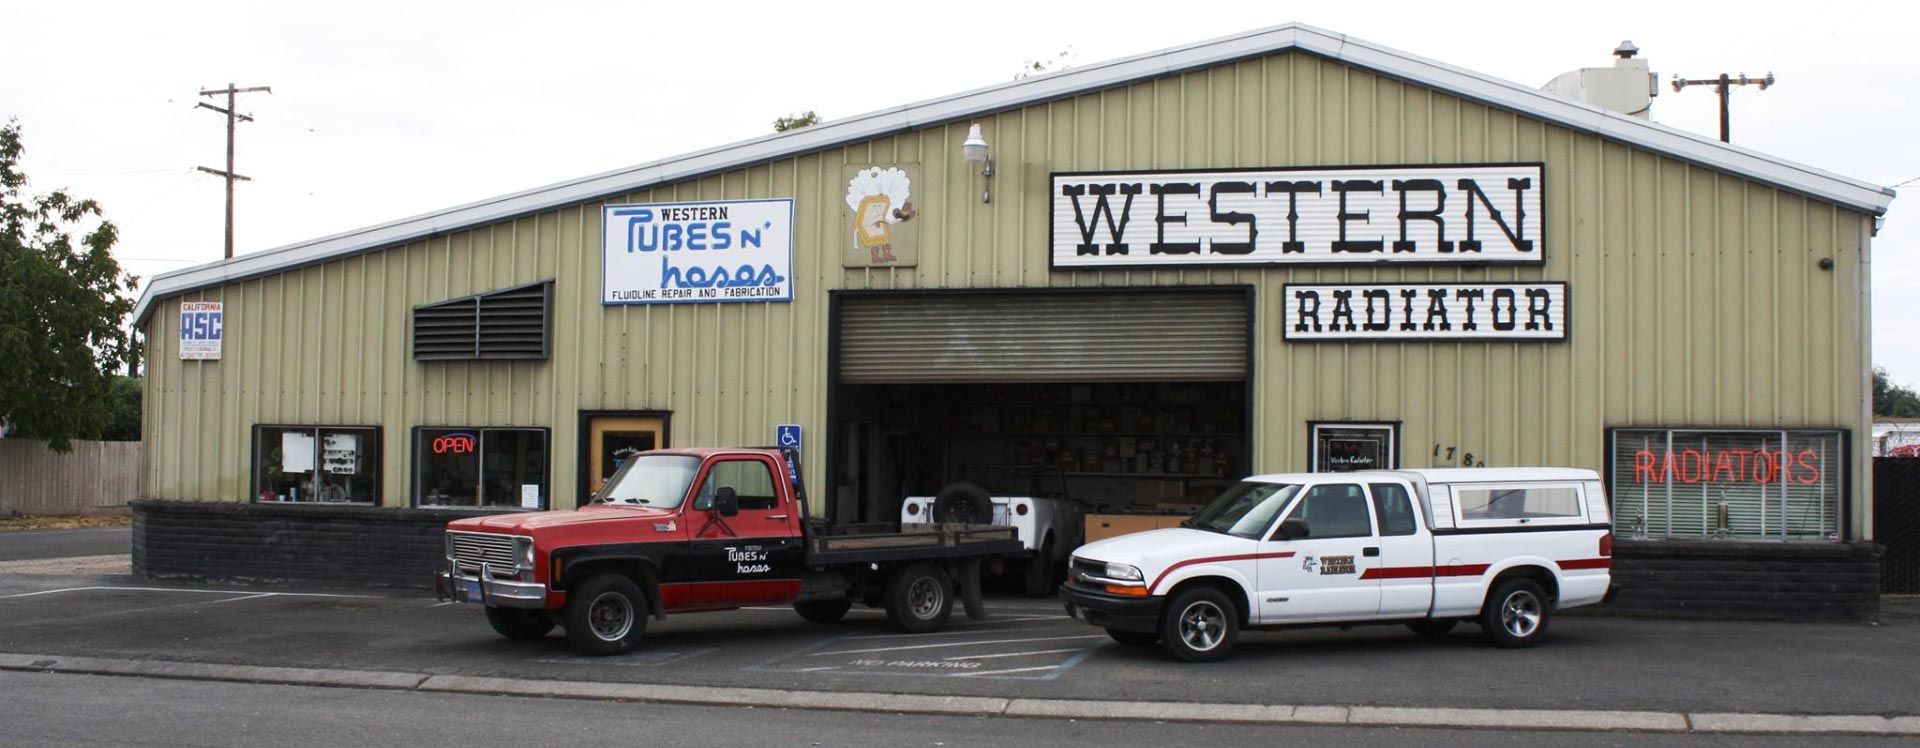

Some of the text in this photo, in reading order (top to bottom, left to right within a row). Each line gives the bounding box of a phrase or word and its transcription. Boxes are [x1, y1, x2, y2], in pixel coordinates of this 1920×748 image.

[661, 207, 728, 221] WESTERN
[1062, 178, 1533, 256] WESTERN
[613, 209, 732, 253] TUBES
[660, 255, 785, 288] hoses
[612, 287, 780, 300] FLUIDLINE REPAIR AND FABRICATION
[1295, 288, 1553, 332] RADIATOR
[181, 312, 221, 340] ASC
[432, 437, 475, 454] OPEN
[1634, 449, 1819, 484] RADIATORS
[724, 546, 757, 562] TUBES
